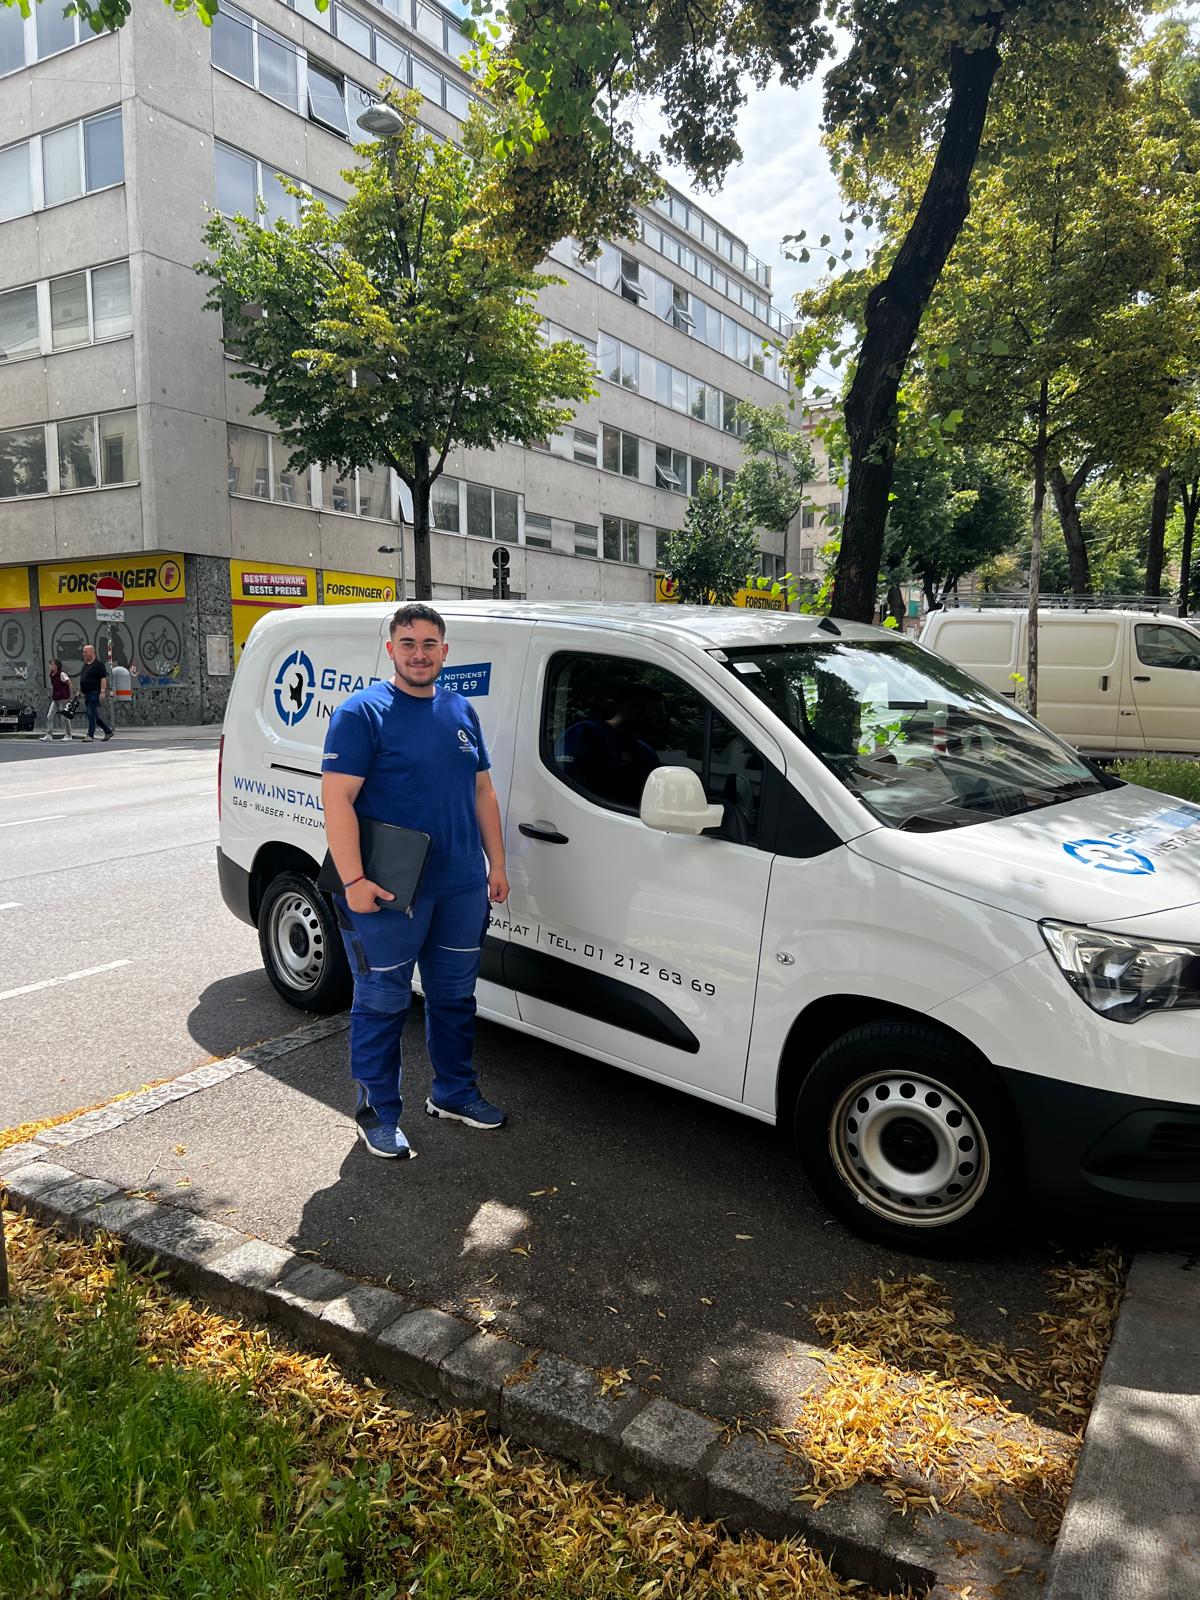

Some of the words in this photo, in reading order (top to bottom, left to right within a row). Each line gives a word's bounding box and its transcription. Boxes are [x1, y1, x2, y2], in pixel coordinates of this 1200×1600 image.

[58, 568, 157, 594] FORSNGER
[244, 574, 269, 584] BESTE
[270, 575, 305, 585] AUSWAHL
[250, 585, 274, 595] BESTE
[275, 586, 301, 596] PREISE
[326, 583, 382, 599] FORSTINGER
[444, 671, 487, 681] NOTDIENST
[444, 682, 458, 691] 63
[462, 680, 477, 690] 69
[233, 775, 324, 811] WWW.INSTAL
[232, 796, 248, 808] GAS
[255, 802, 285, 819] WASSER
[547, 932, 577, 952] TEL.
[584, 944, 603, 961] 01
[614, 953, 650, 976] 212
[658, 968, 682, 986] 63
[691, 979, 716, 996] 69
